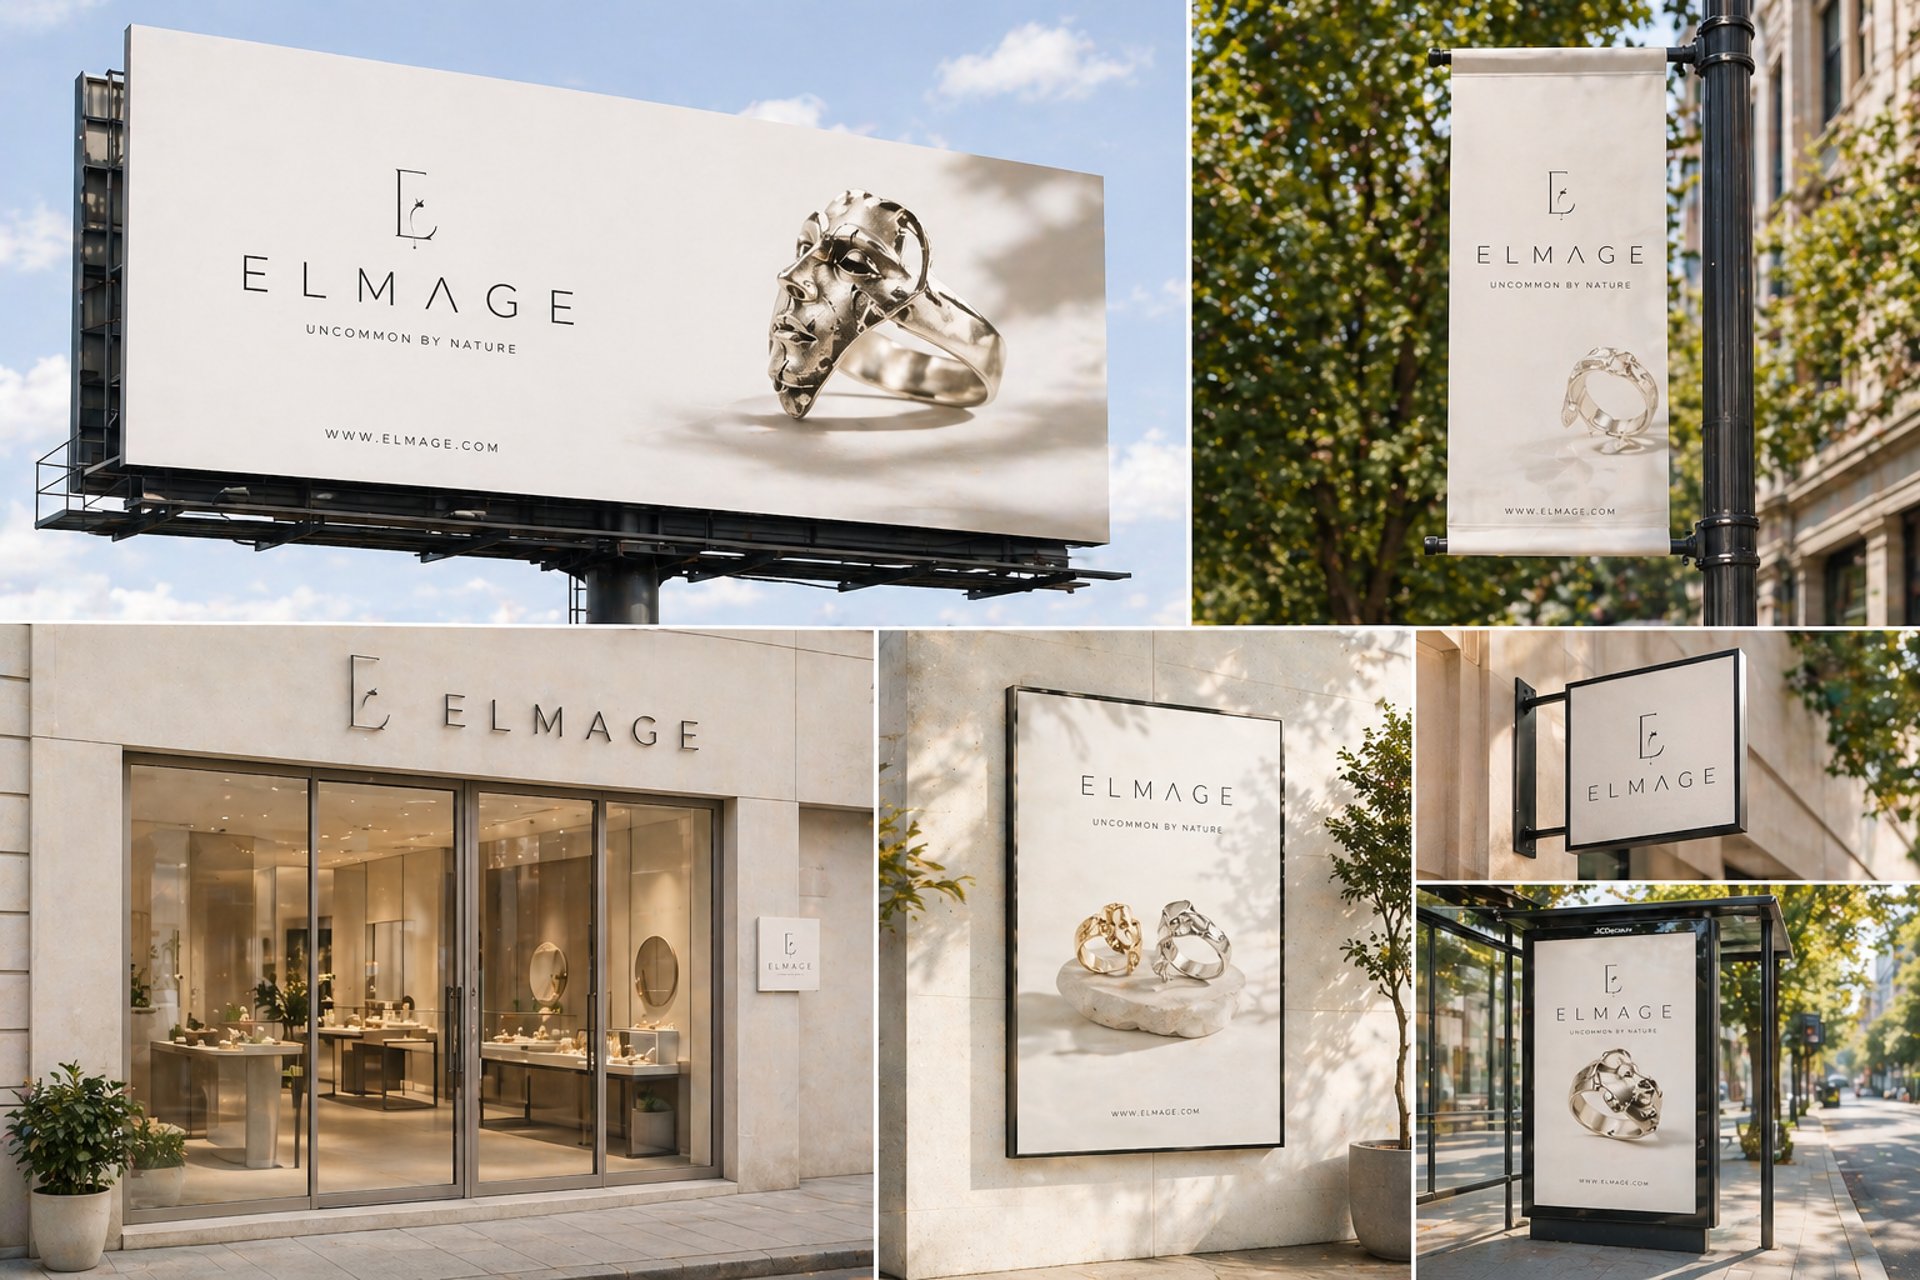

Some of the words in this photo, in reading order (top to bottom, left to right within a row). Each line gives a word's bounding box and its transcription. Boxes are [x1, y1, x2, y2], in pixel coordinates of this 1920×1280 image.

[1477, 245, 1643, 265] ELMAGE
[243, 254, 576, 327] ELMAGE
[1490, 280, 1560, 289] UNCOMMON
[1566, 281, 1580, 289] BY
[1586, 281, 1631, 289] NATURE
[306, 323, 412, 344] UNCOMMON
[420, 335, 441, 347] BY
[450, 338, 517, 355] NATURE
[325, 428, 499, 453] WWW.ELMAGE.COM
[1504, 507, 1615, 516] WWW.ELMAGE.COM
[443, 693, 700, 751] ELMAGE
[1081, 774, 1233, 806] ELMAGE
[1588, 767, 1715, 802] ELMAGE
[1092, 818, 1159, 830] UNCOMMON
[1164, 822, 1177, 831] BY
[1182, 824, 1223, 835] NATURE
[768, 962, 812, 971] ELMAGE
[1556, 1004, 1672, 1021] ELMAGE
[1110, 1108, 1200, 1117] WWW.ELMAGE.COM
